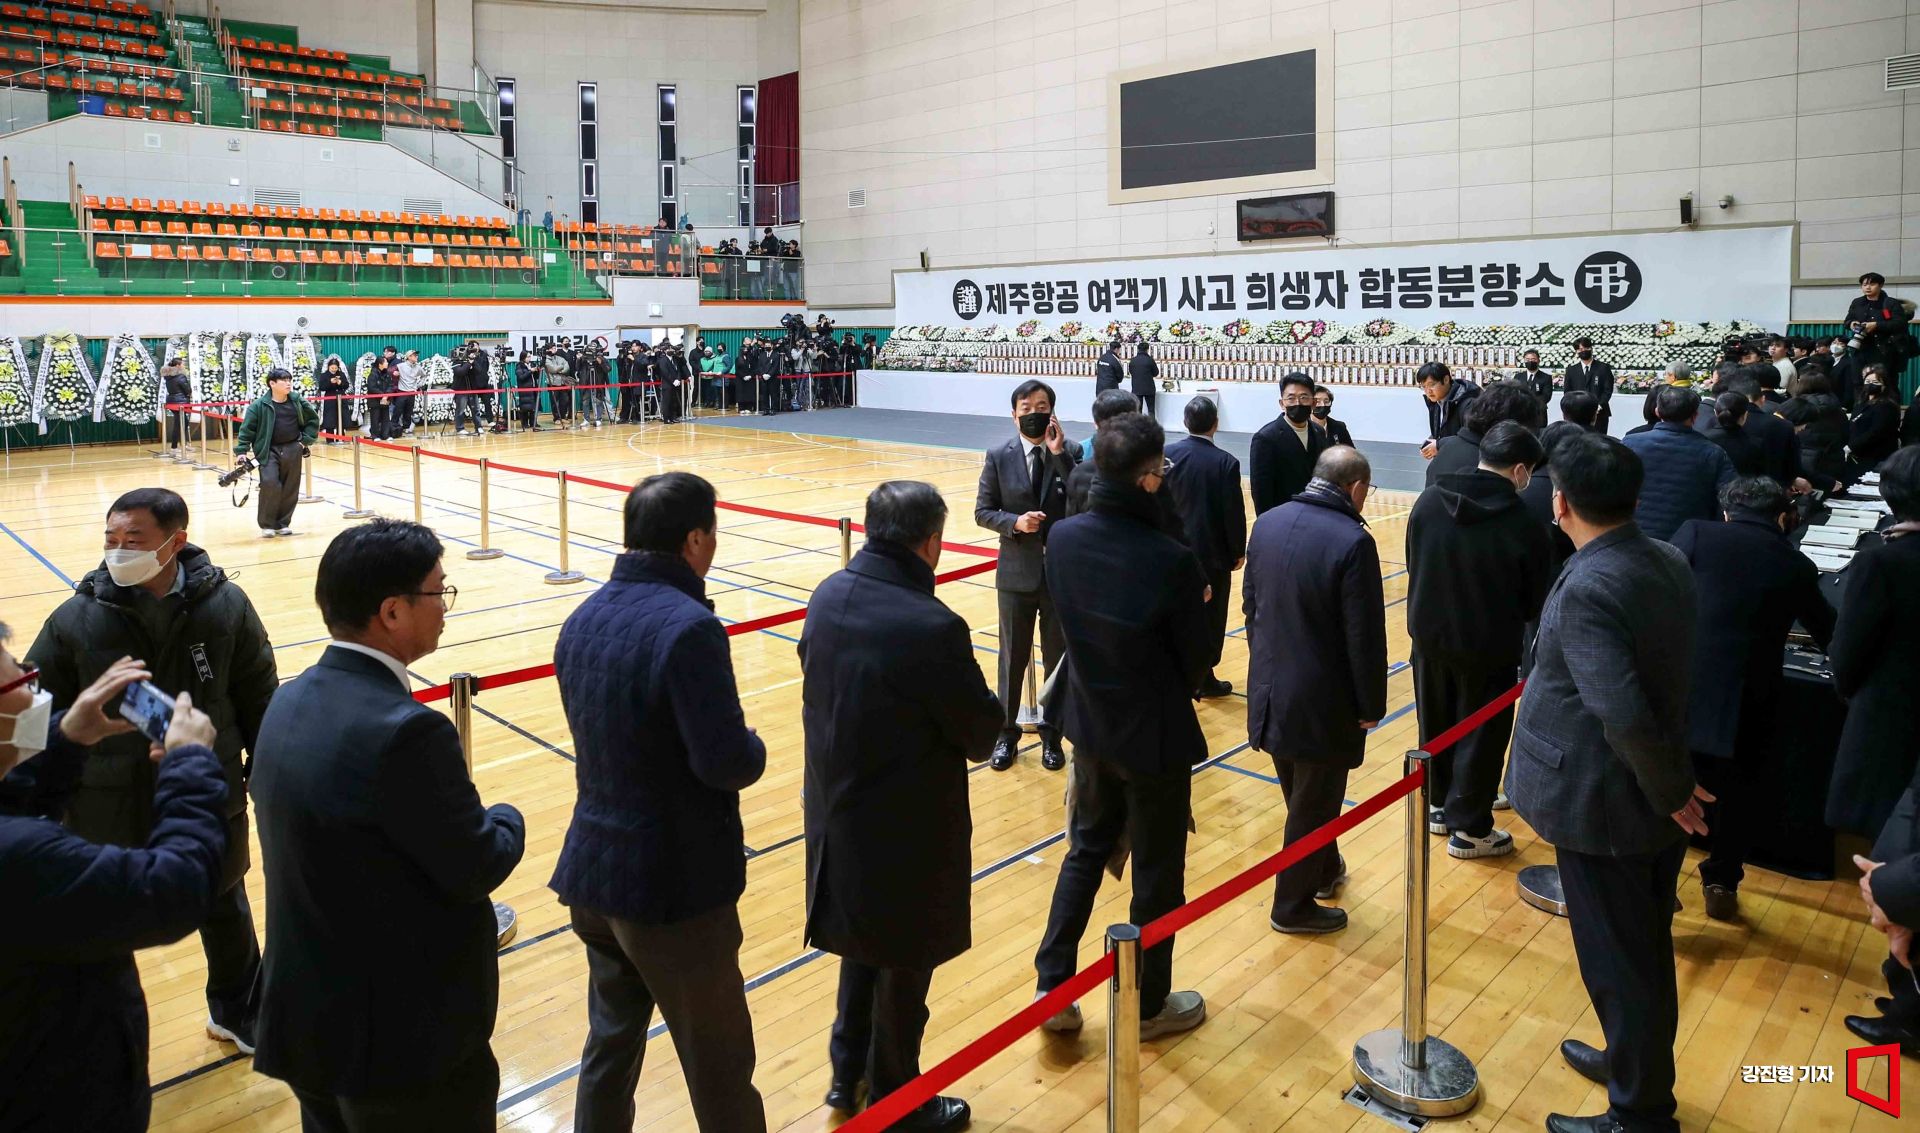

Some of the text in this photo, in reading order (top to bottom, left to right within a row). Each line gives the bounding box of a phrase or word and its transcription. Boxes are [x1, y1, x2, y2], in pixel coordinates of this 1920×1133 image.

[985, 261, 1566, 315] 제주항공 여객기 사고 희생자 합동분향소
